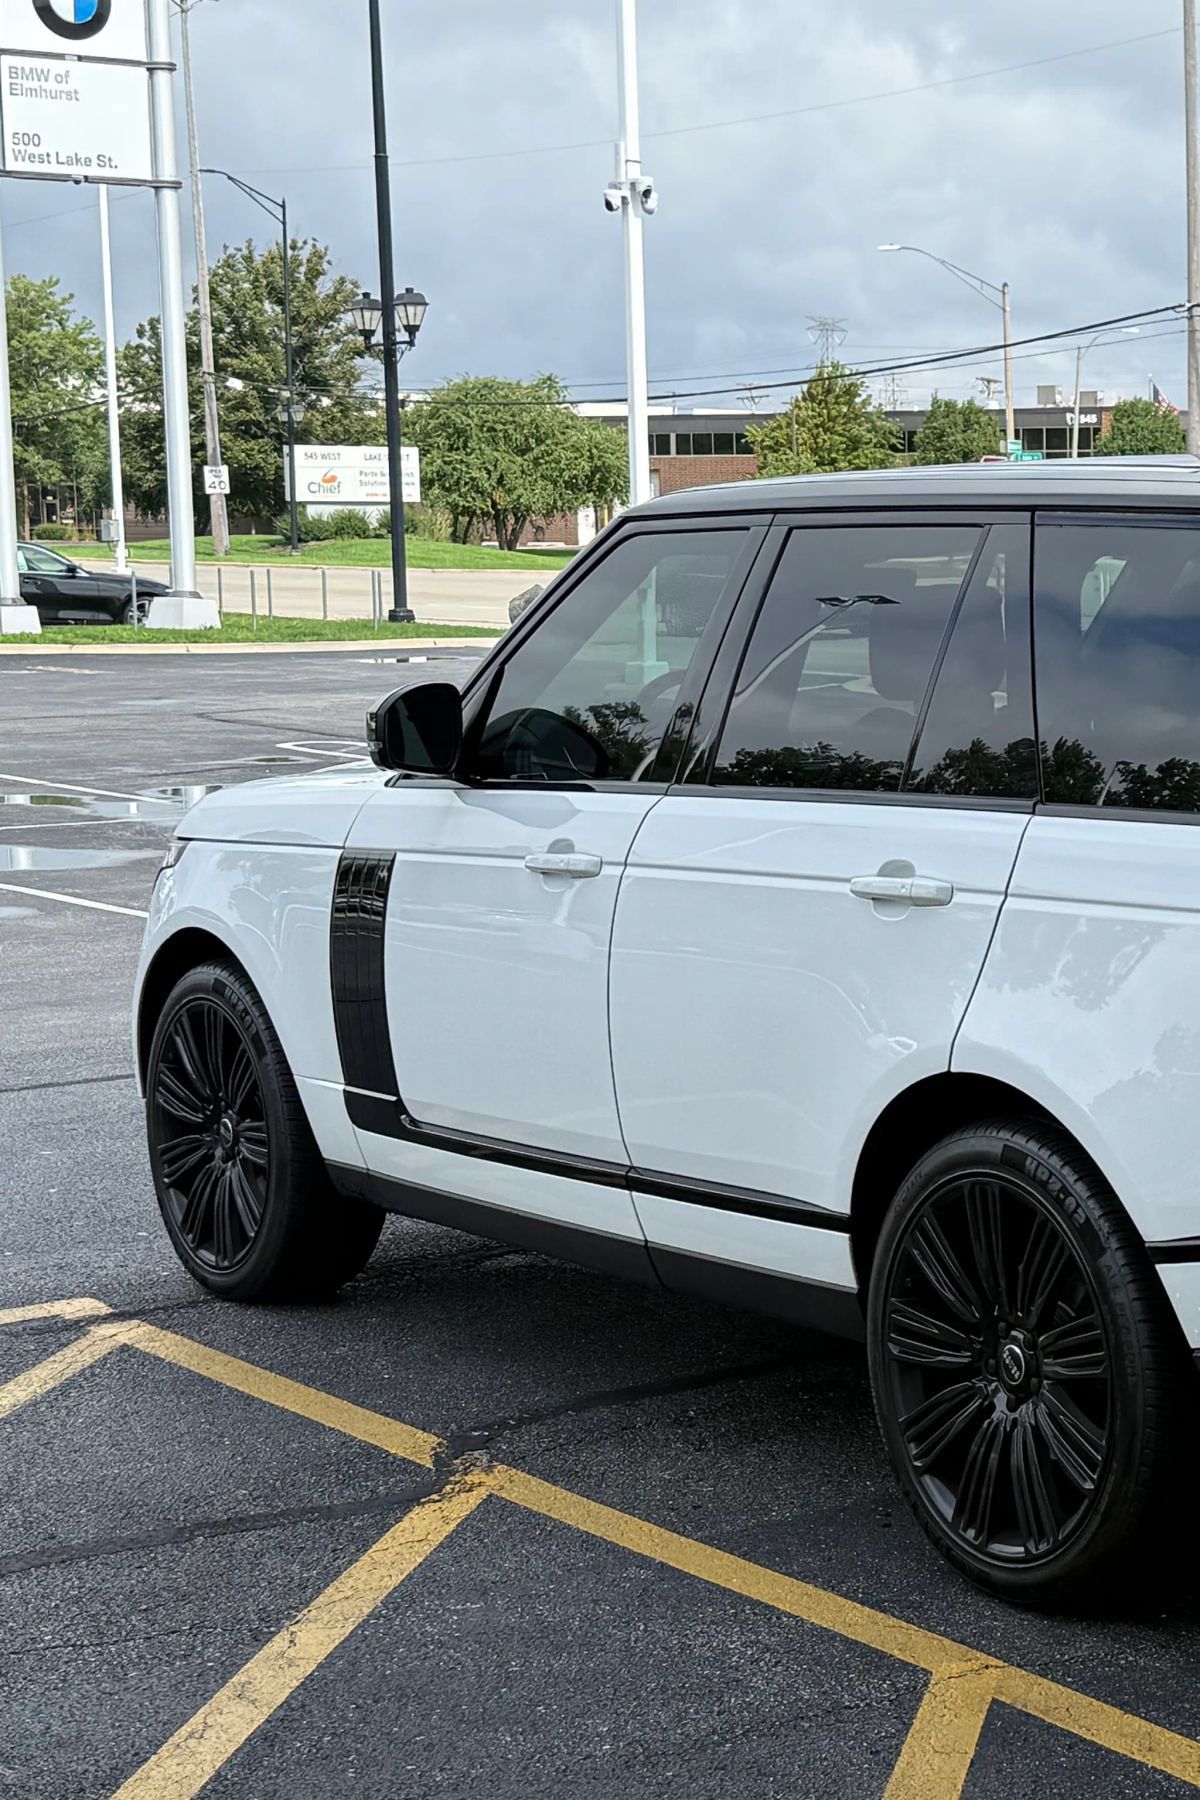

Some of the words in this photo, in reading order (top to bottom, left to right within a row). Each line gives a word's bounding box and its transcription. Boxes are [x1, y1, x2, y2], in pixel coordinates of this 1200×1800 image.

[8, 65, 50, 83] BMW
[54, 70, 71, 84] of
[9, 82, 80, 101] Elmhurst
[12, 132, 41, 147] 500
[12, 148, 52, 164] West
[56, 151, 92, 167] Lake
[96, 154, 118, 169] St.
[320, 452, 341, 461] WEST
[208, 480, 226, 490] 40
[307, 481, 341, 494] Chief
